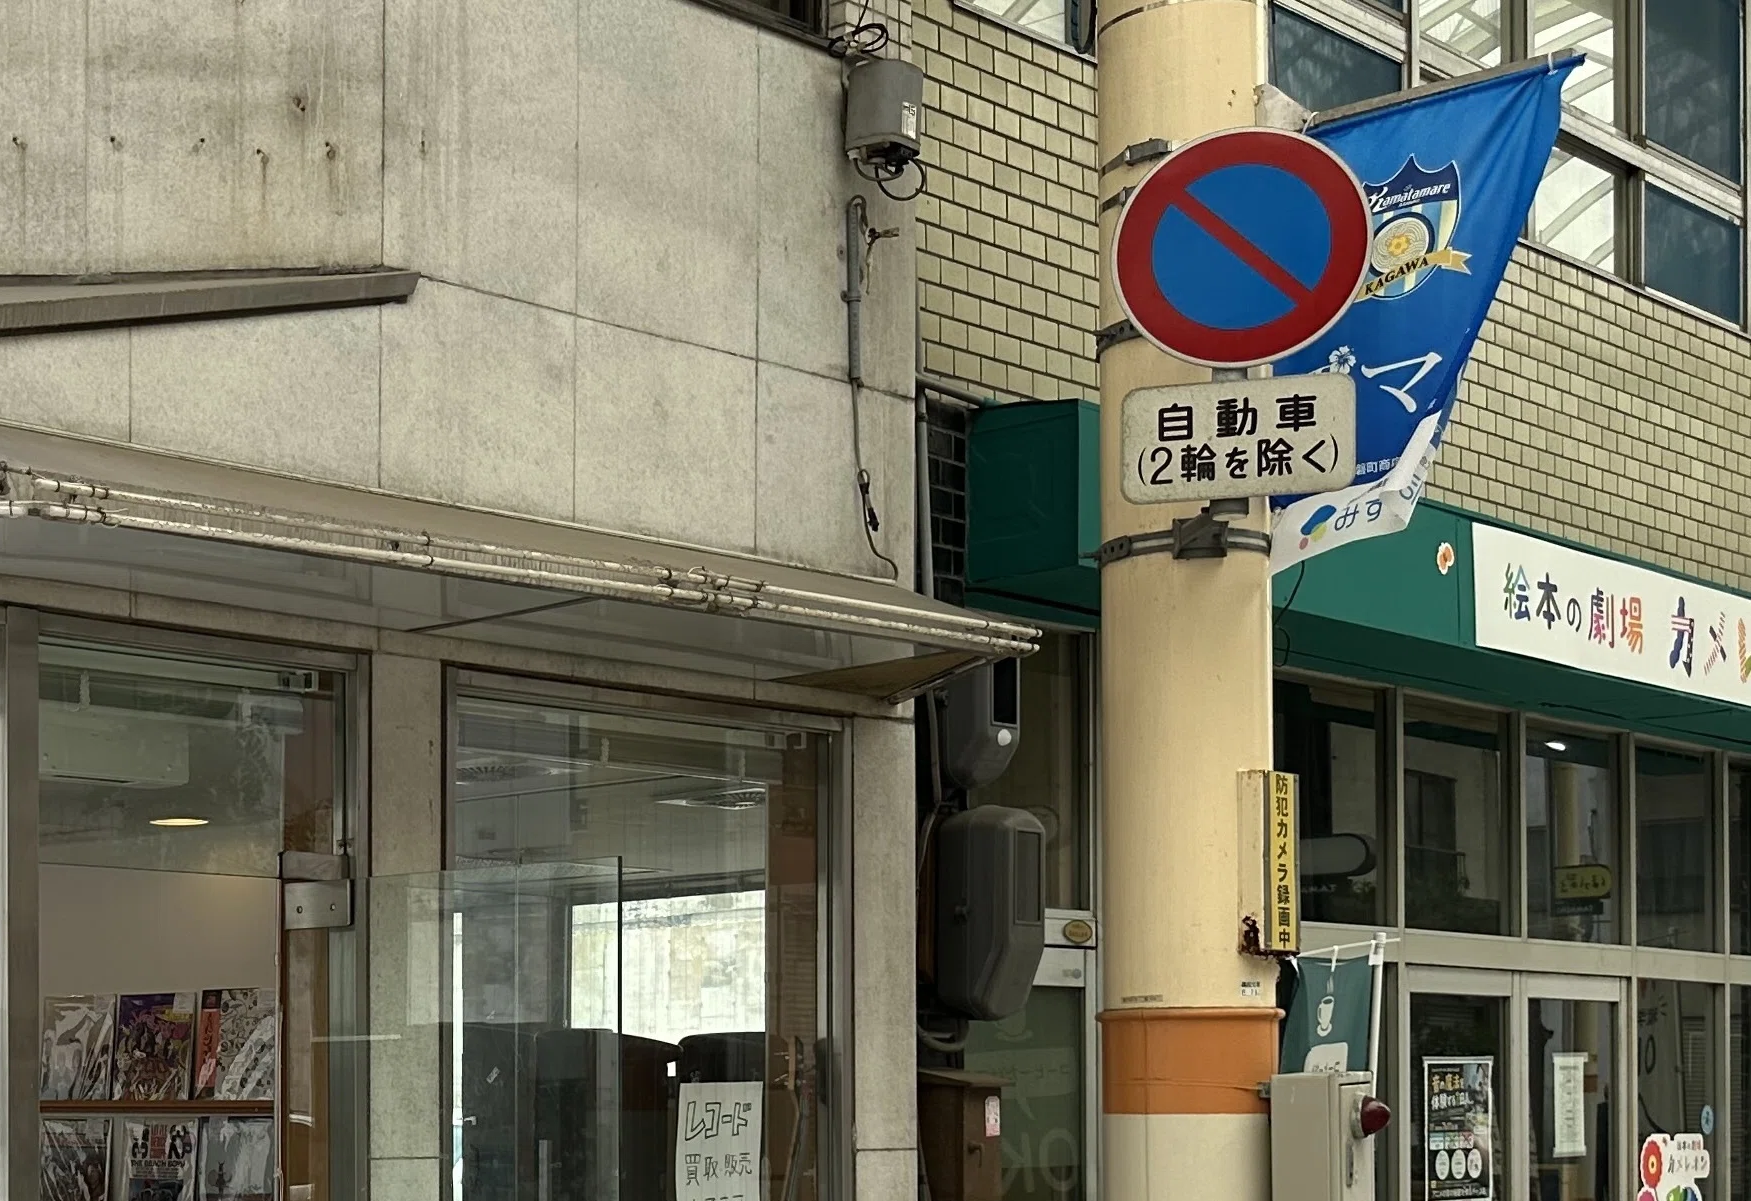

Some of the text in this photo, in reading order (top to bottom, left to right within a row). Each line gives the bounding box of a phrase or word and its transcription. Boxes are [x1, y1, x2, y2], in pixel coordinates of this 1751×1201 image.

[1365, 256, 1429, 295] KAGAWA
[1157, 393, 1317, 443] 自動車
[1138, 435, 1339, 486] (2輪を除く)
[1504, 562, 1643, 655] 絵本の劇場
[1275, 773, 1290, 949] 防犯カメラ録画中
[685, 1101, 751, 1141] レコード
[685, 1152, 752, 1186] 買取販売
